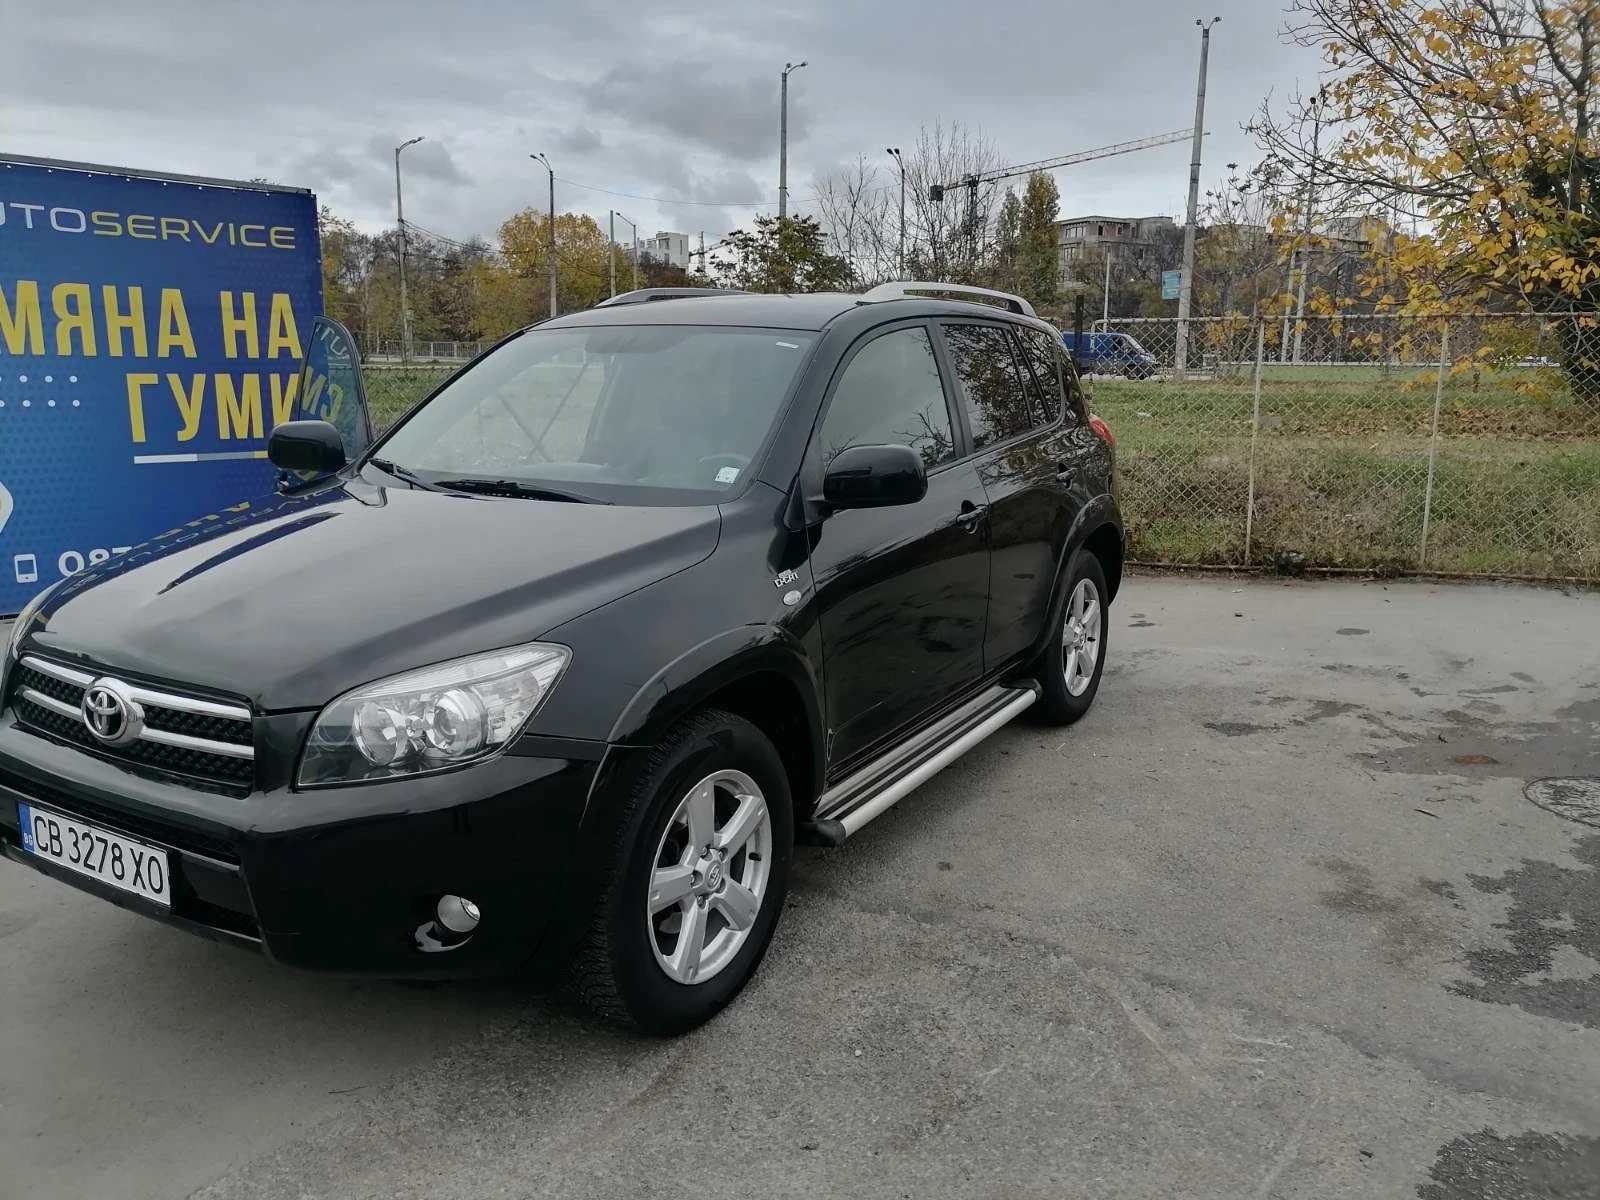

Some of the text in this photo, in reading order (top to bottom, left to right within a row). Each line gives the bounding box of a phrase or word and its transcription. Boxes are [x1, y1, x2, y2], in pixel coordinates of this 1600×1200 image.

[0, 202, 296, 249] TOSERVICE
[220, 291, 303, 359] НА
[34, 815, 63, 858] CB
[68, 827, 125, 880] 3278
